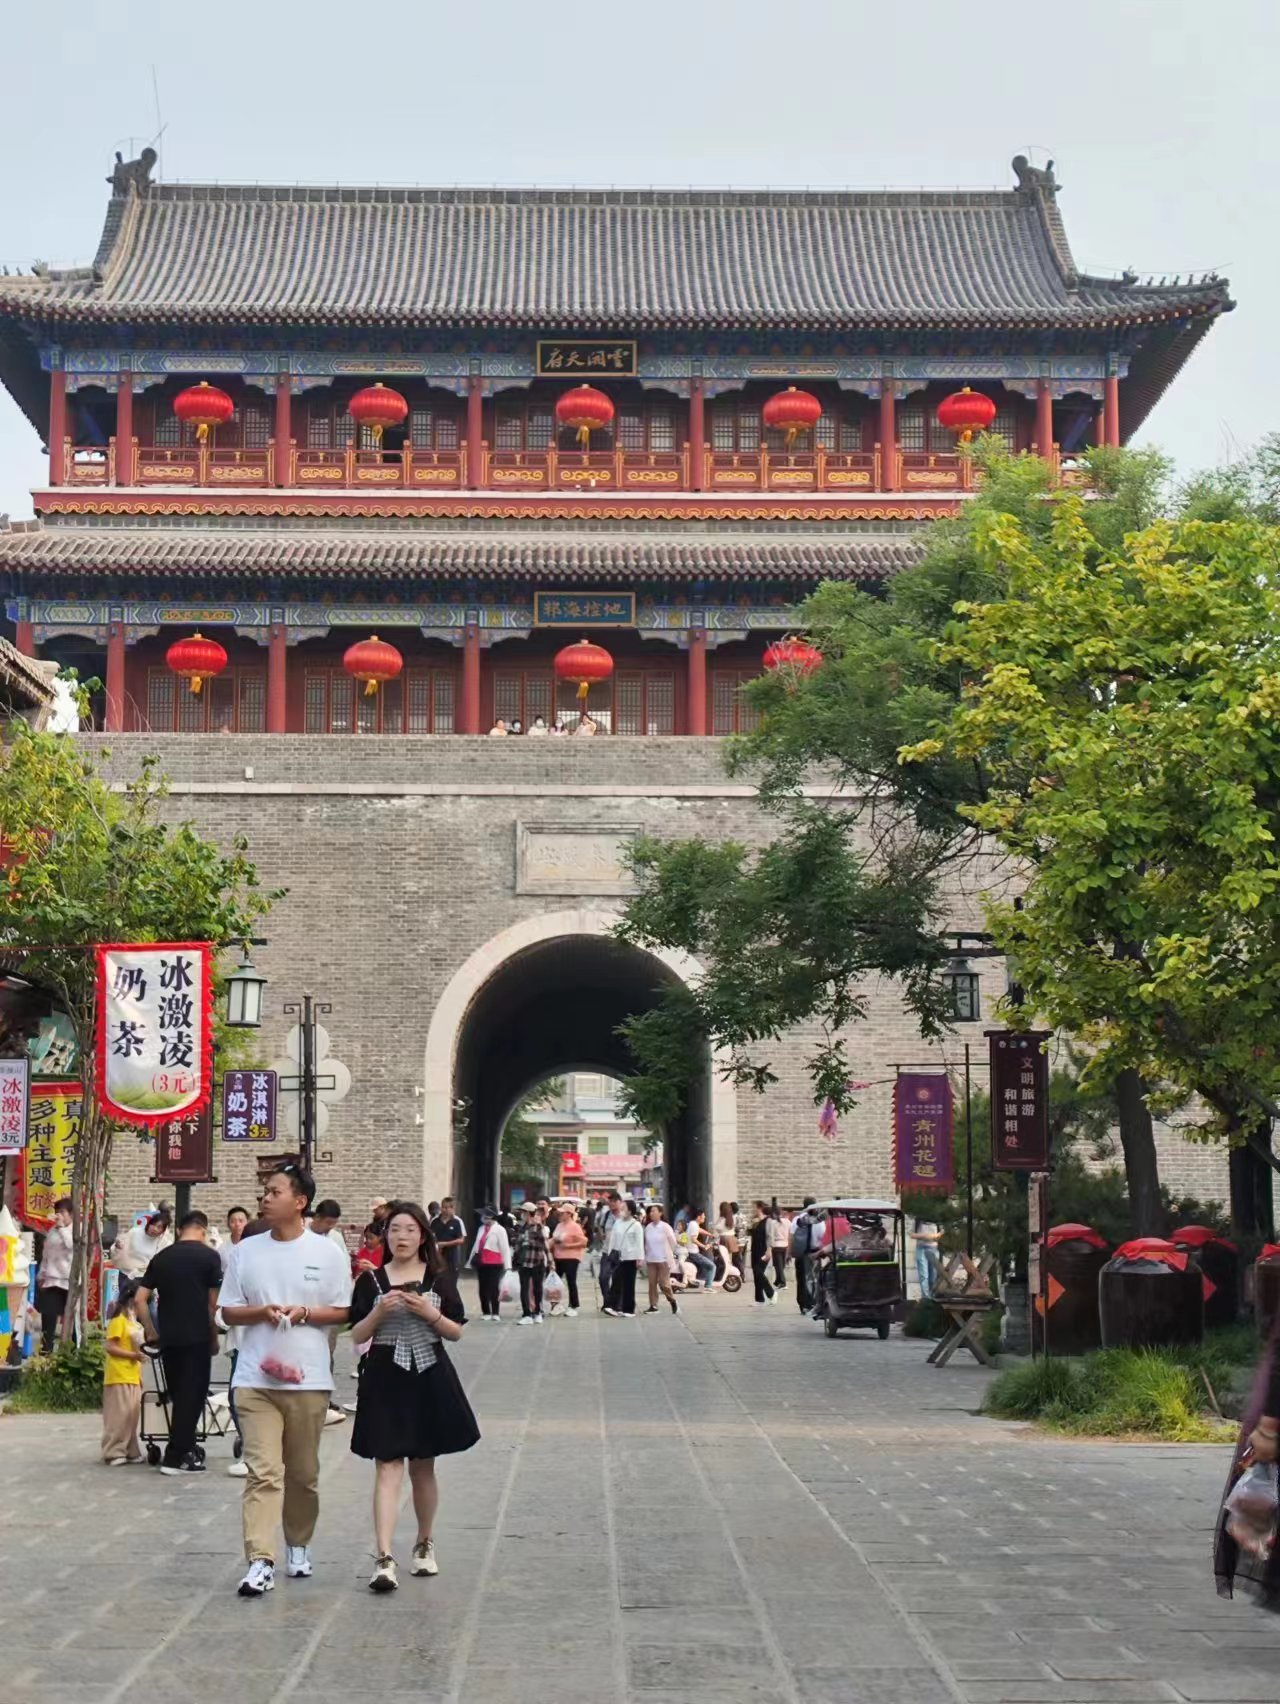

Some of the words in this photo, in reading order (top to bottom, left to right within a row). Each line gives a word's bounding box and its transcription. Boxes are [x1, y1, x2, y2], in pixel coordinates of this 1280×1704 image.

[111, 965, 147, 1058] 奶茶
[158, 955, 194, 1068] 冰激凌
[2, 1078, 22, 1132] 冰激凌
[227, 1092, 248, 1137] 奶茶
[252, 1073, 268, 1125] 冰淇淋
[1021, 1056, 1035, 1117] 文明旅游
[2, 1132, 20, 1144] 3元
[30, 1099, 57, 1187] 多种主题
[249, 1124, 270, 1138] 3元
[1004, 1088, 1019, 1148] 和谐相处
